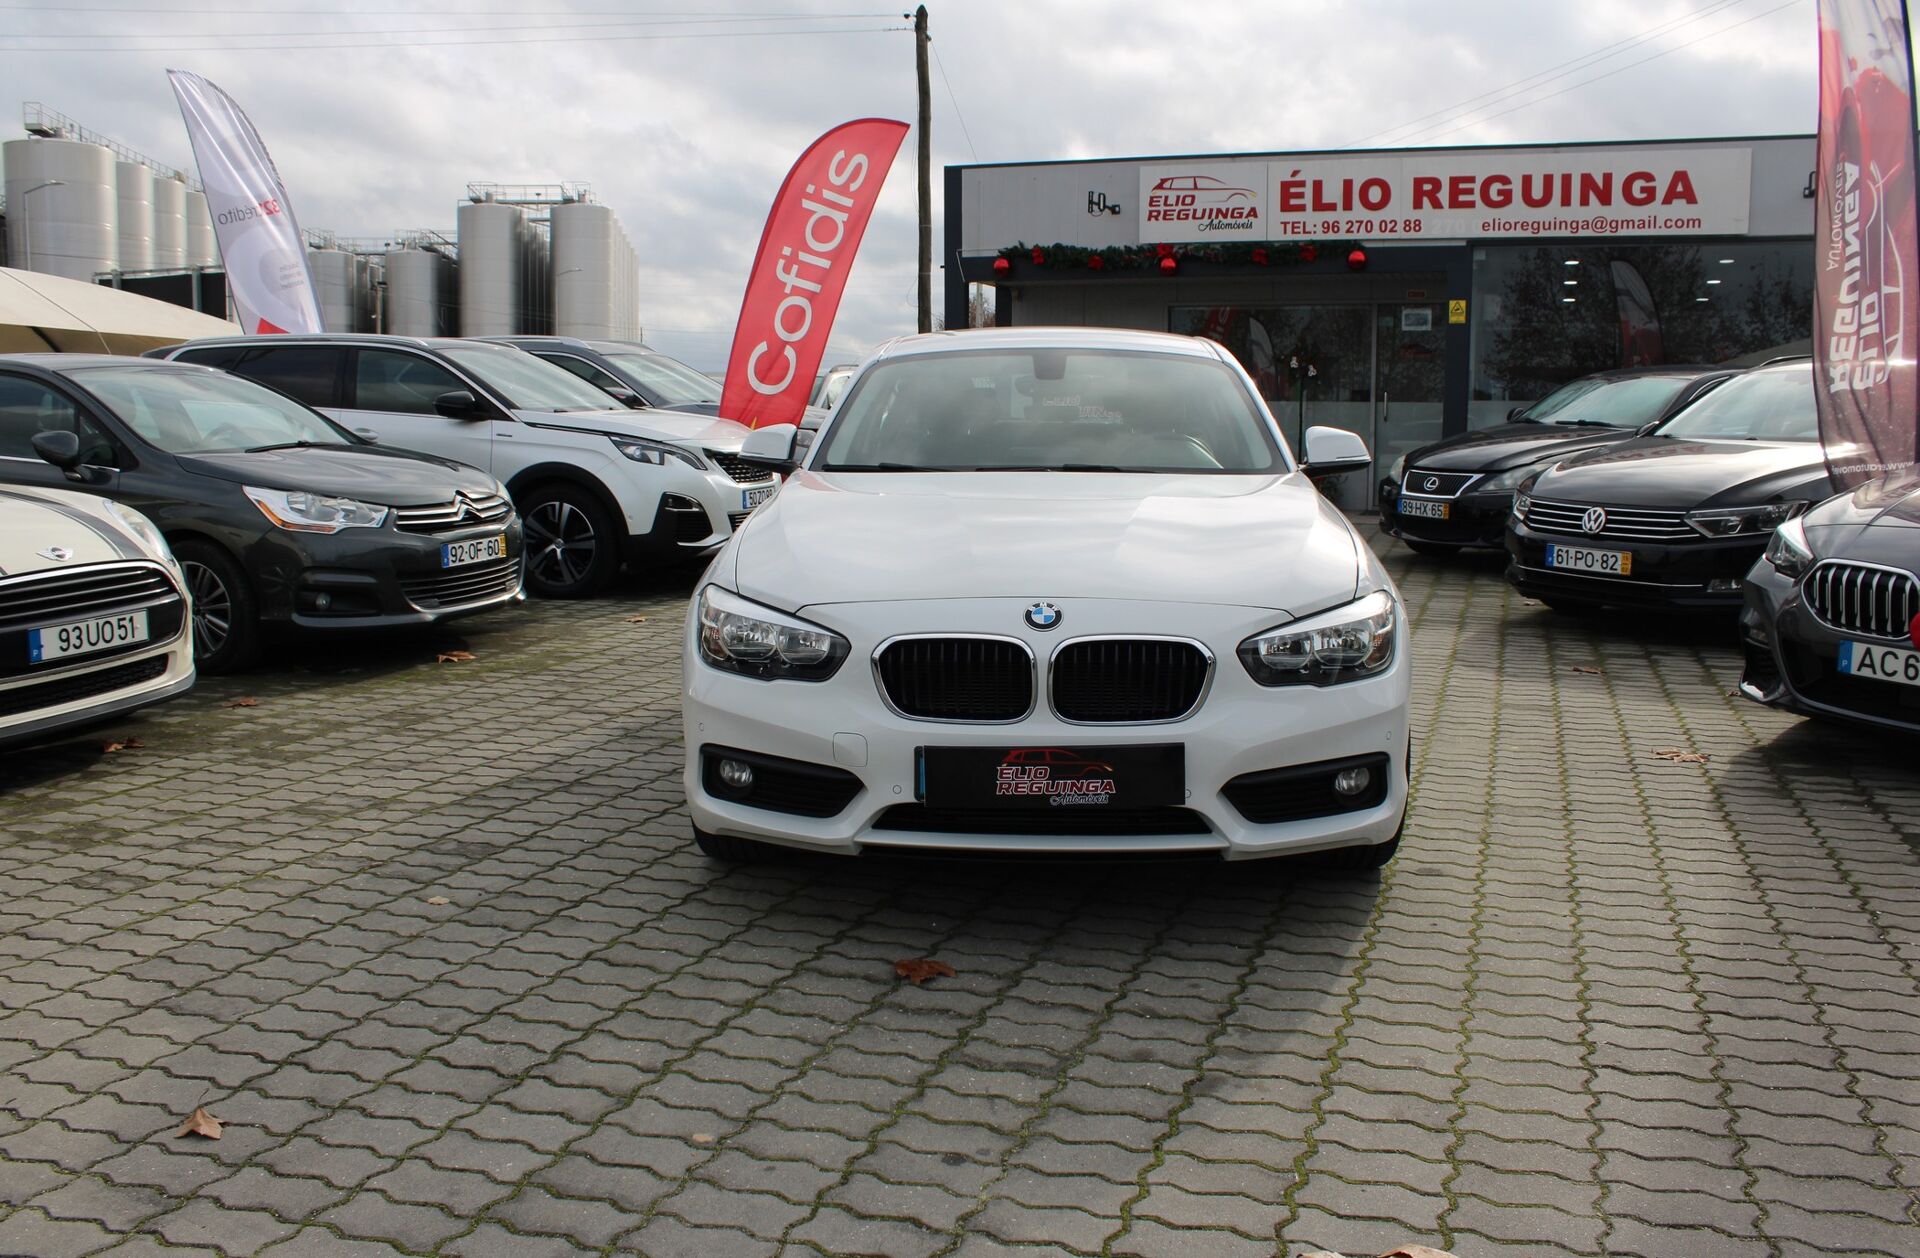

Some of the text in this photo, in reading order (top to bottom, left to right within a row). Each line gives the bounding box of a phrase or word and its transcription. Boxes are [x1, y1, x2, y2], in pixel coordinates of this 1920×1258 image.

[1148, 194, 1196, 208] ELIO
[1280, 170, 1699, 212] ÉLIO REGUINGA
[1147, 207, 1259, 221] REGUINGA
[1280, 215, 1702, 235] TEL: 96 270 02 88 elioreguinga@gmail.com
[747, 149, 869, 395] Cofidis
[1856, 646, 1920, 681] AC6
[995, 780, 1116, 795] REGUINGA
